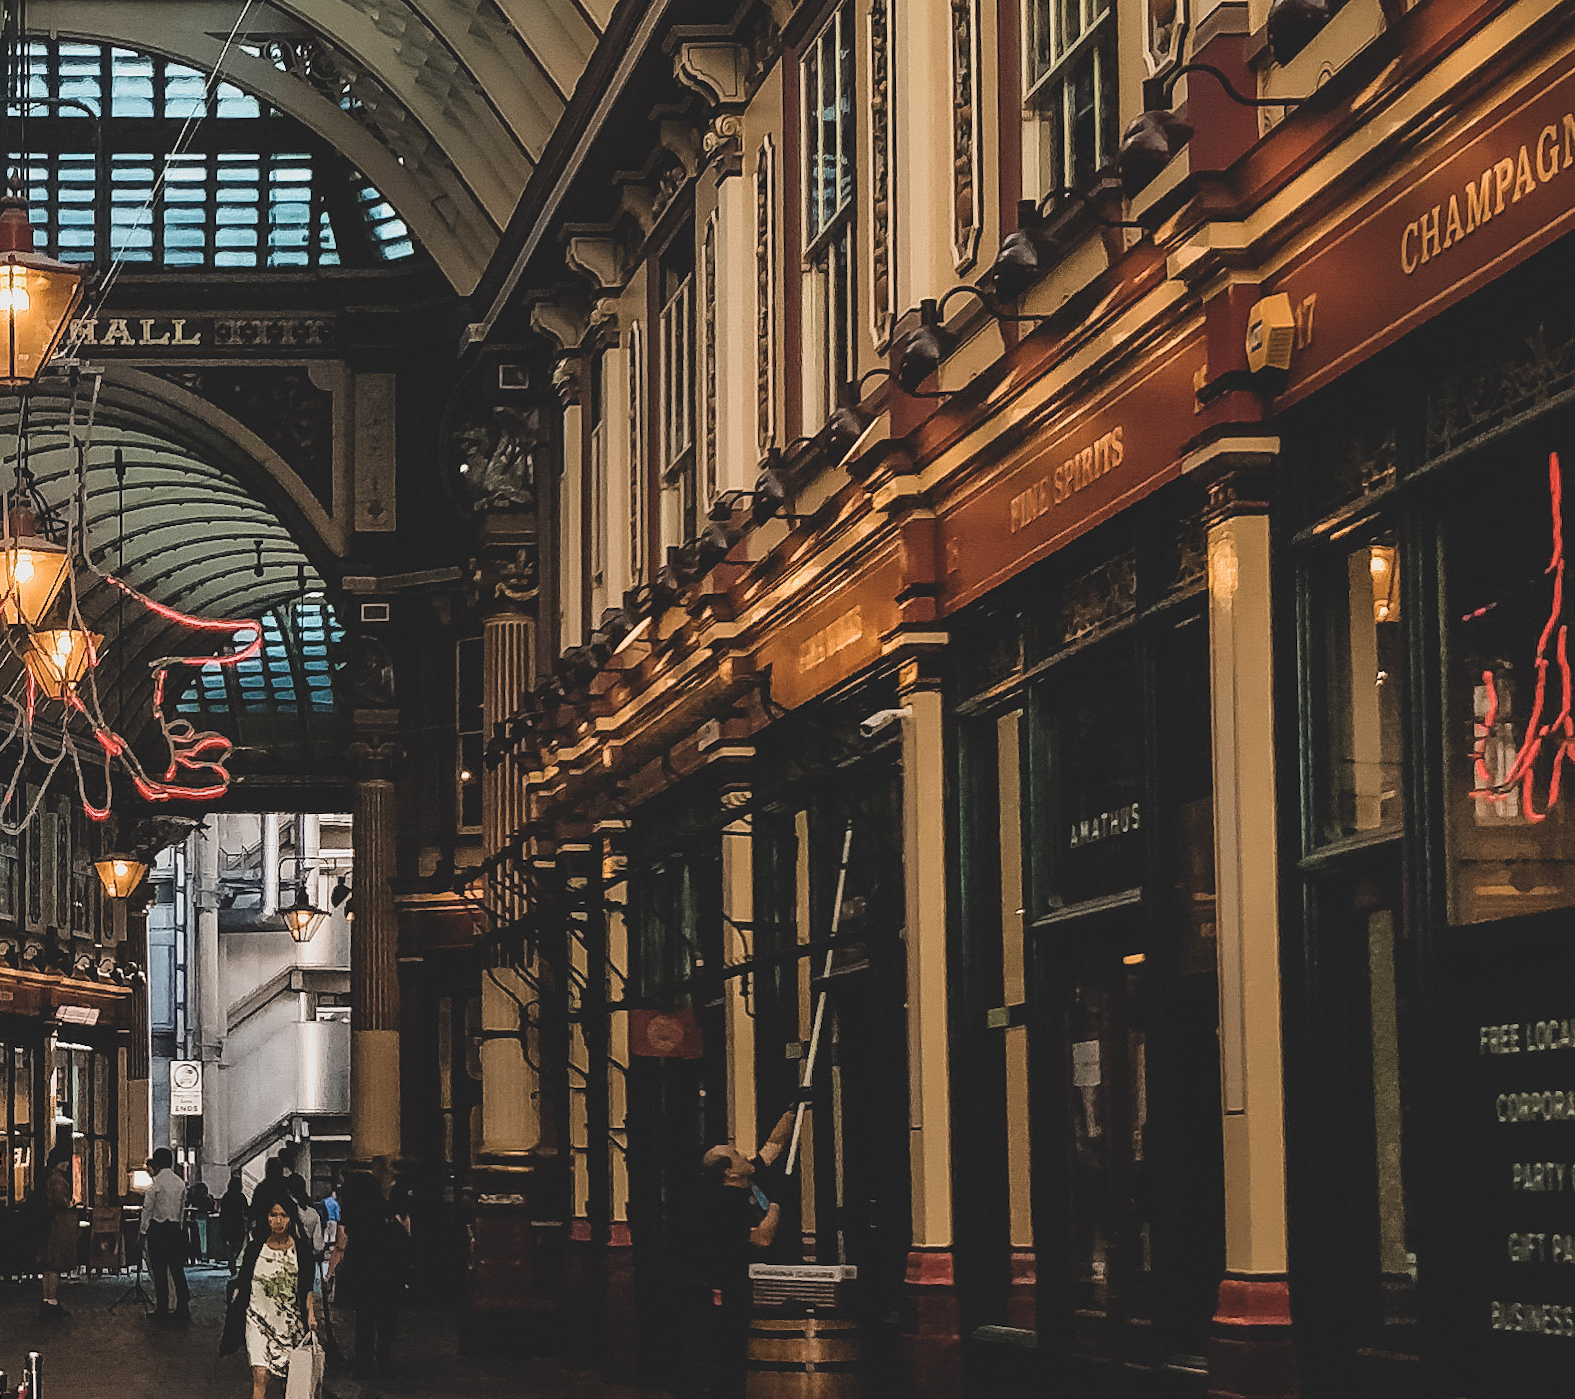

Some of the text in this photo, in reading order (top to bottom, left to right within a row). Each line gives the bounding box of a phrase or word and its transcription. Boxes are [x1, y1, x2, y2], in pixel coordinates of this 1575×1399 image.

[1053, 425, 1124, 505] SPIRITS
[1069, 802, 1140, 848] AMATHUS
[1479, 1023, 1520, 1055] FREE
[1512, 1162, 1566, 1192] PARTY
[1508, 1232, 1546, 1263] GIFT
[1491, 1301, 1573, 1337] BUSINESS
